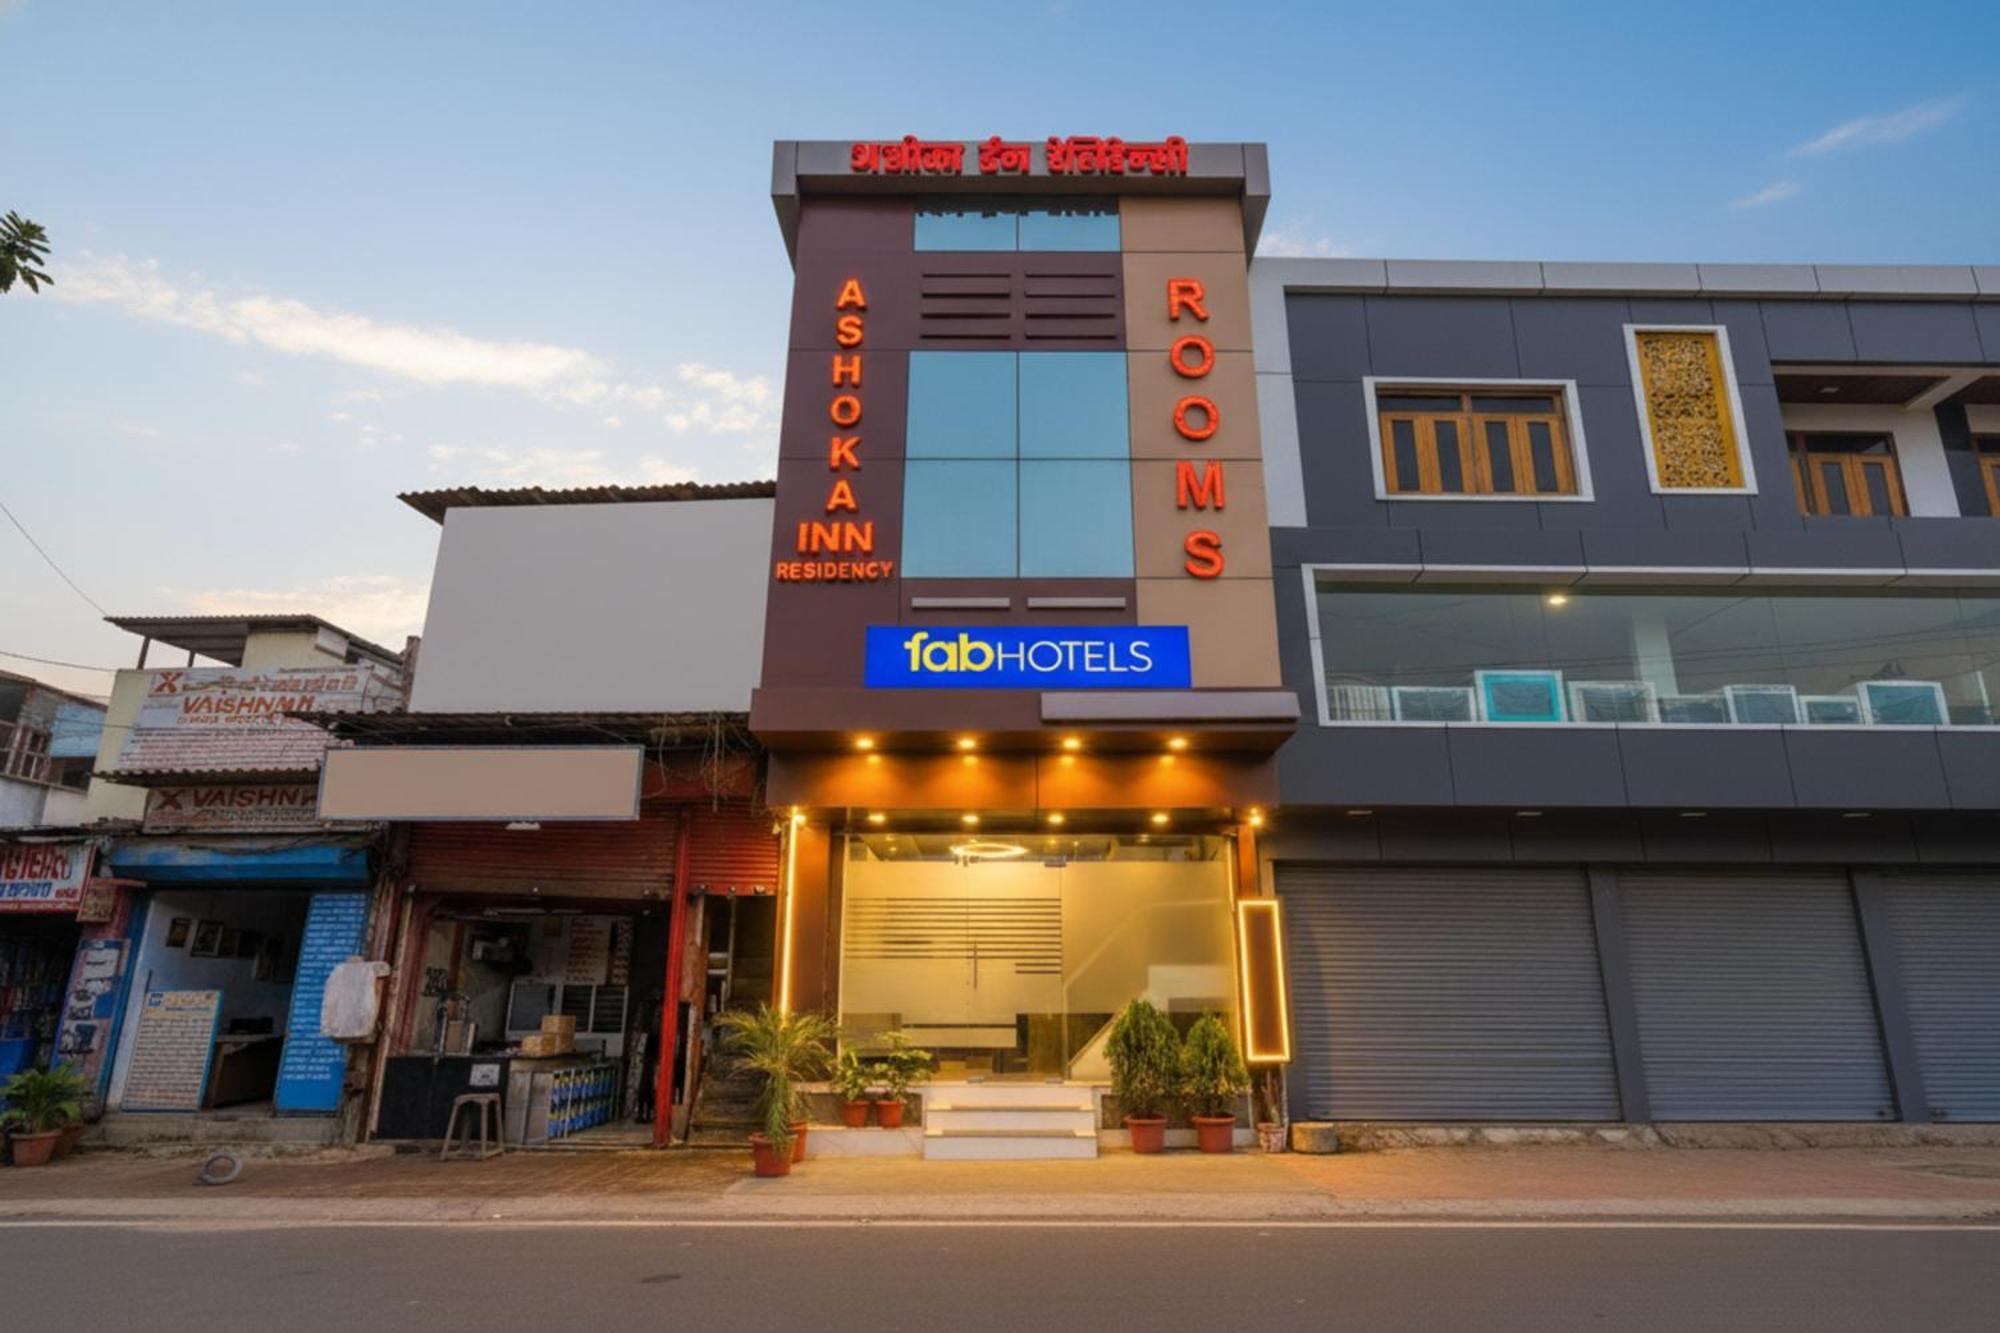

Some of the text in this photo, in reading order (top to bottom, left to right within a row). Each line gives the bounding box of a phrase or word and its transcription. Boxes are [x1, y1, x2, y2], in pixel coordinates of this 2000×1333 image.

[827, 278, 866, 512] ASHOKA
[1166, 277, 1226, 579] ROOMS
[776, 560, 893, 581] RESIDENCY
[797, 521, 873, 552] INN
